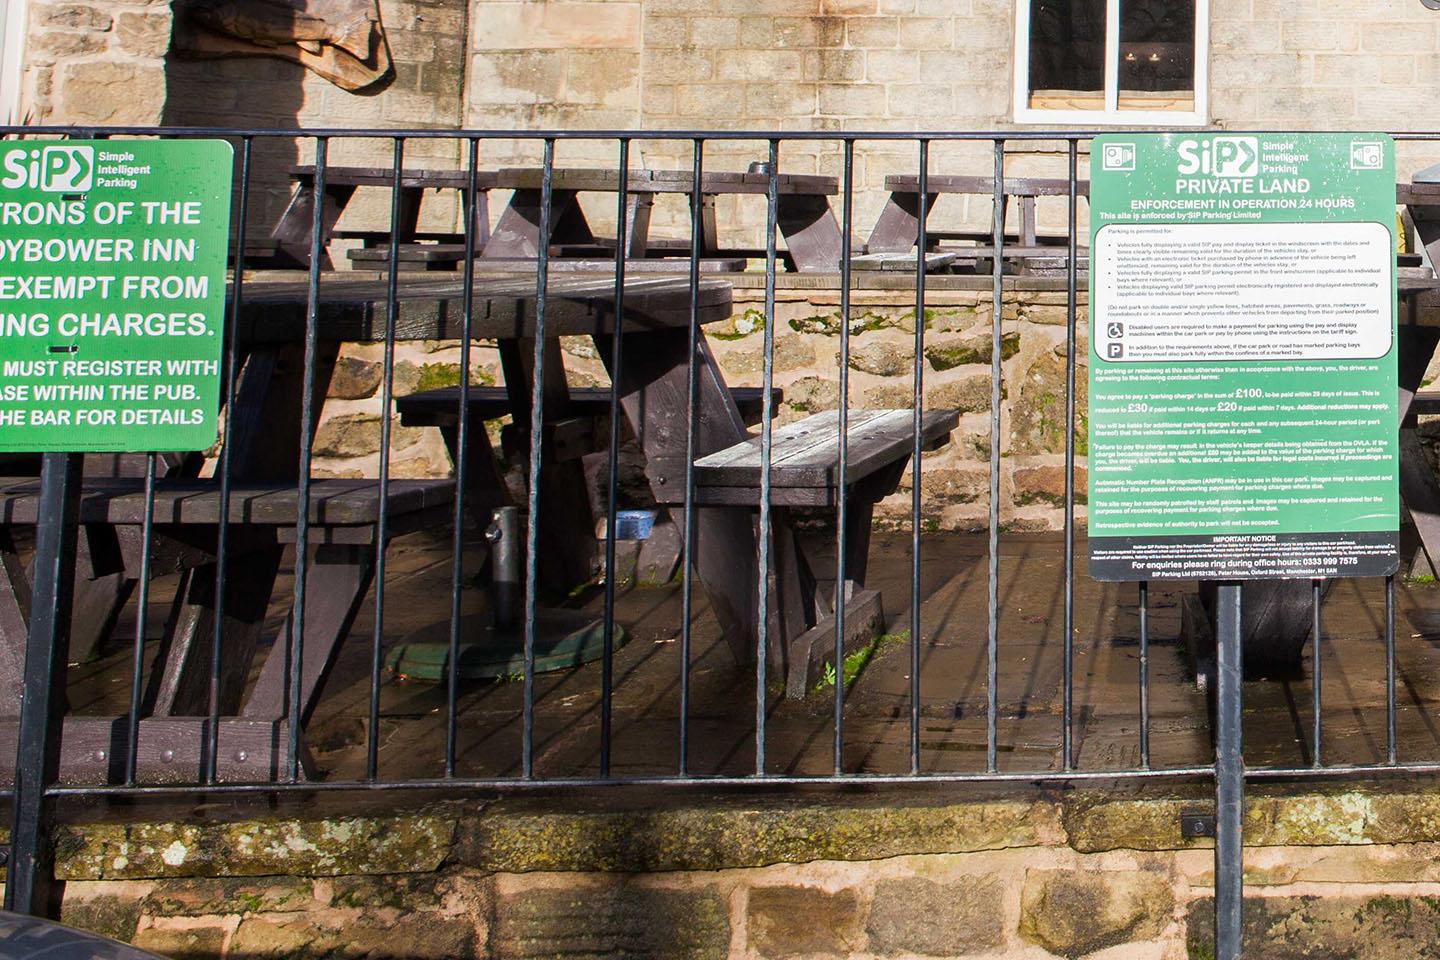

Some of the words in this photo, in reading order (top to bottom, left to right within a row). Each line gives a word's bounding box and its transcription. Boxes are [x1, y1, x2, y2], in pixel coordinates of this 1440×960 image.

[1262, 141, 1295, 153] Simple
[98, 151, 135, 164] Simple
[1262, 153, 1309, 165] Intelligent
[97, 164, 151, 176] Intelligent
[1262, 164, 1298, 176] Parking
[96, 177, 138, 189] Parking
[1176, 179, 1253, 194] PRIVATE
[1259, 178, 1310, 194] LAND
[1131, 199, 1214, 210] ENFORCEMENT
[1218, 199, 1229, 209] IN
[1232, 199, 1296, 209] OPERATION
[1299, 197, 1312, 209] 24
[1315, 197, 1354, 208] HOURS
[0, 202, 86, 225] RONS
[94, 202, 133, 225] OF
[141, 201, 202, 225] THE
[1100, 212, 1116, 220] This
[1117, 212, 1132, 220] site
[1141, 212, 1175, 220] enforced
[1176, 212, 1186, 222] by
[1202, 211, 1232, 221] Parking
[1233, 211, 1261, 220] Limited
[0, 239, 134, 262] YBOWER
[142, 239, 195, 262] INN
[0, 276, 115, 299] EXEMPT
[122, 276, 208, 299] FROM
[58, 312, 214, 337] CHARGES.
[4, 360, 59, 377] MUST
[62, 360, 161, 376] REGISTER
[166, 360, 218, 376] WITH
[0, 385, 28, 401] SE
[33, 385, 104, 401] WITHIN
[109, 385, 149, 400] THE
[154, 385, 201, 401] PUB.
[1236, 388, 1264, 398] £100,
[1128, 403, 1148, 413] £30
[1217, 402, 1237, 412] £20
[30, 410, 71, 426] BAR
[75, 409, 116, 425] FOR
[120, 409, 204, 425] DETAILS
[1132, 561, 1144, 569] For
[1146, 561, 1182, 570] enquiries
[1183, 561, 1209, 569] please
[1210, 560, 1226, 569] ring
[1227, 559, 1253, 569] during
[1254, 559, 1276, 567] office
[1277, 558, 1302, 567] hours:
[1302, 558, 1321, 566] 0333
[1323, 557, 1337, 566] 999
[1339, 557, 1357, 565] 7575
